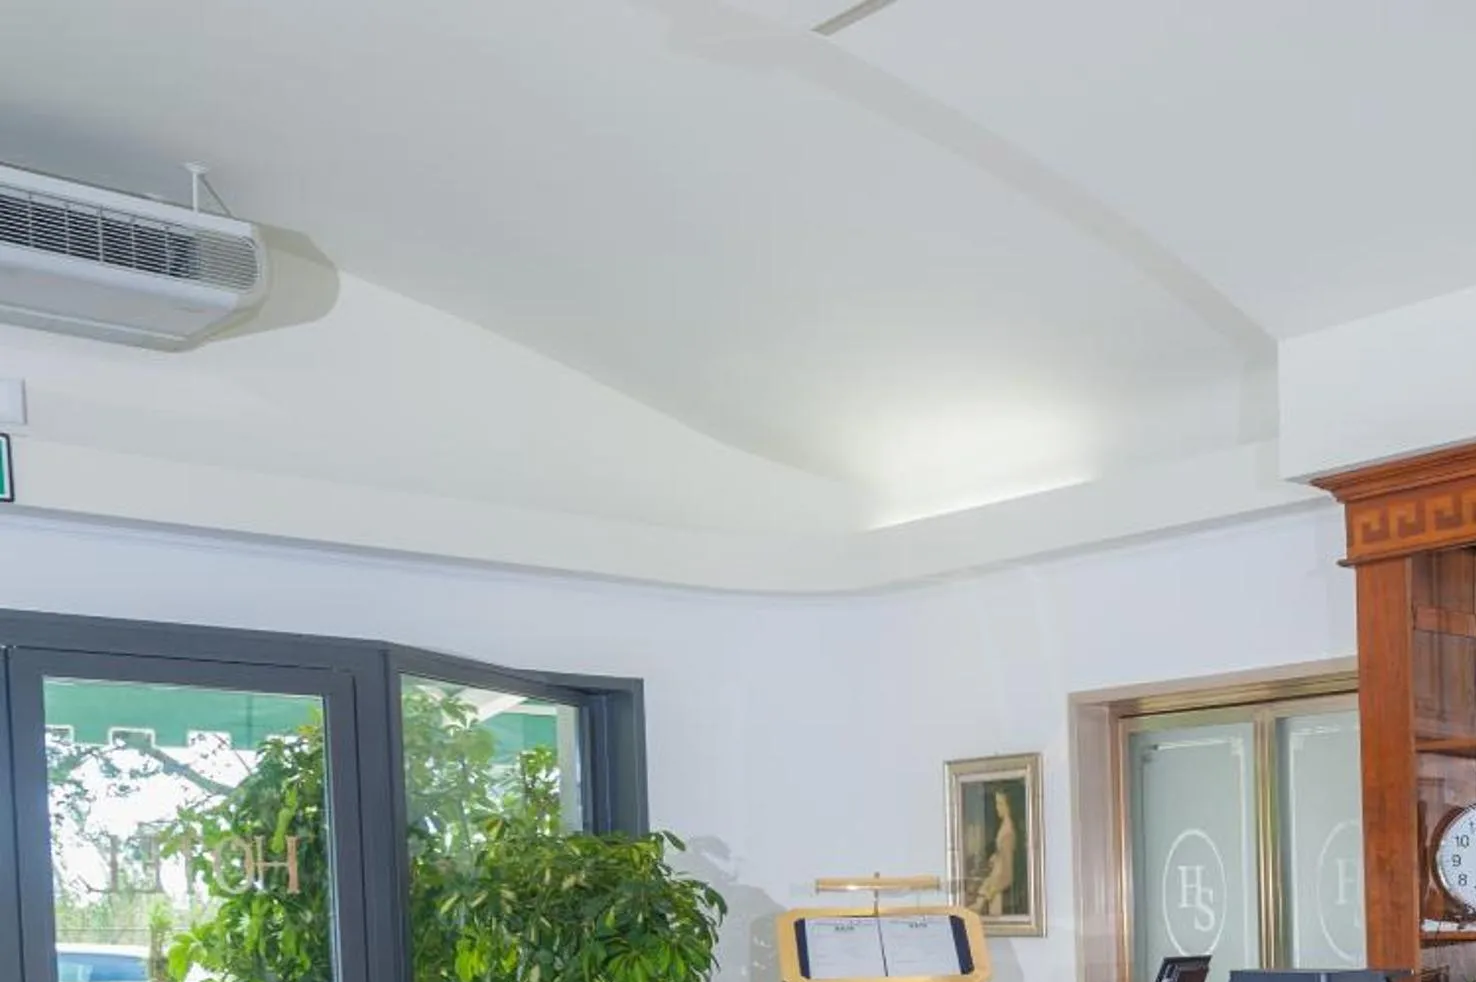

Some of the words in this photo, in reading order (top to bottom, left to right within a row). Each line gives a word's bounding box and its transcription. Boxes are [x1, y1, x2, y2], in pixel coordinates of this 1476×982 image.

[1455, 835, 1470, 848] 10
[1451, 854, 1462, 868] 9
[1458, 874, 1468, 887] 8
